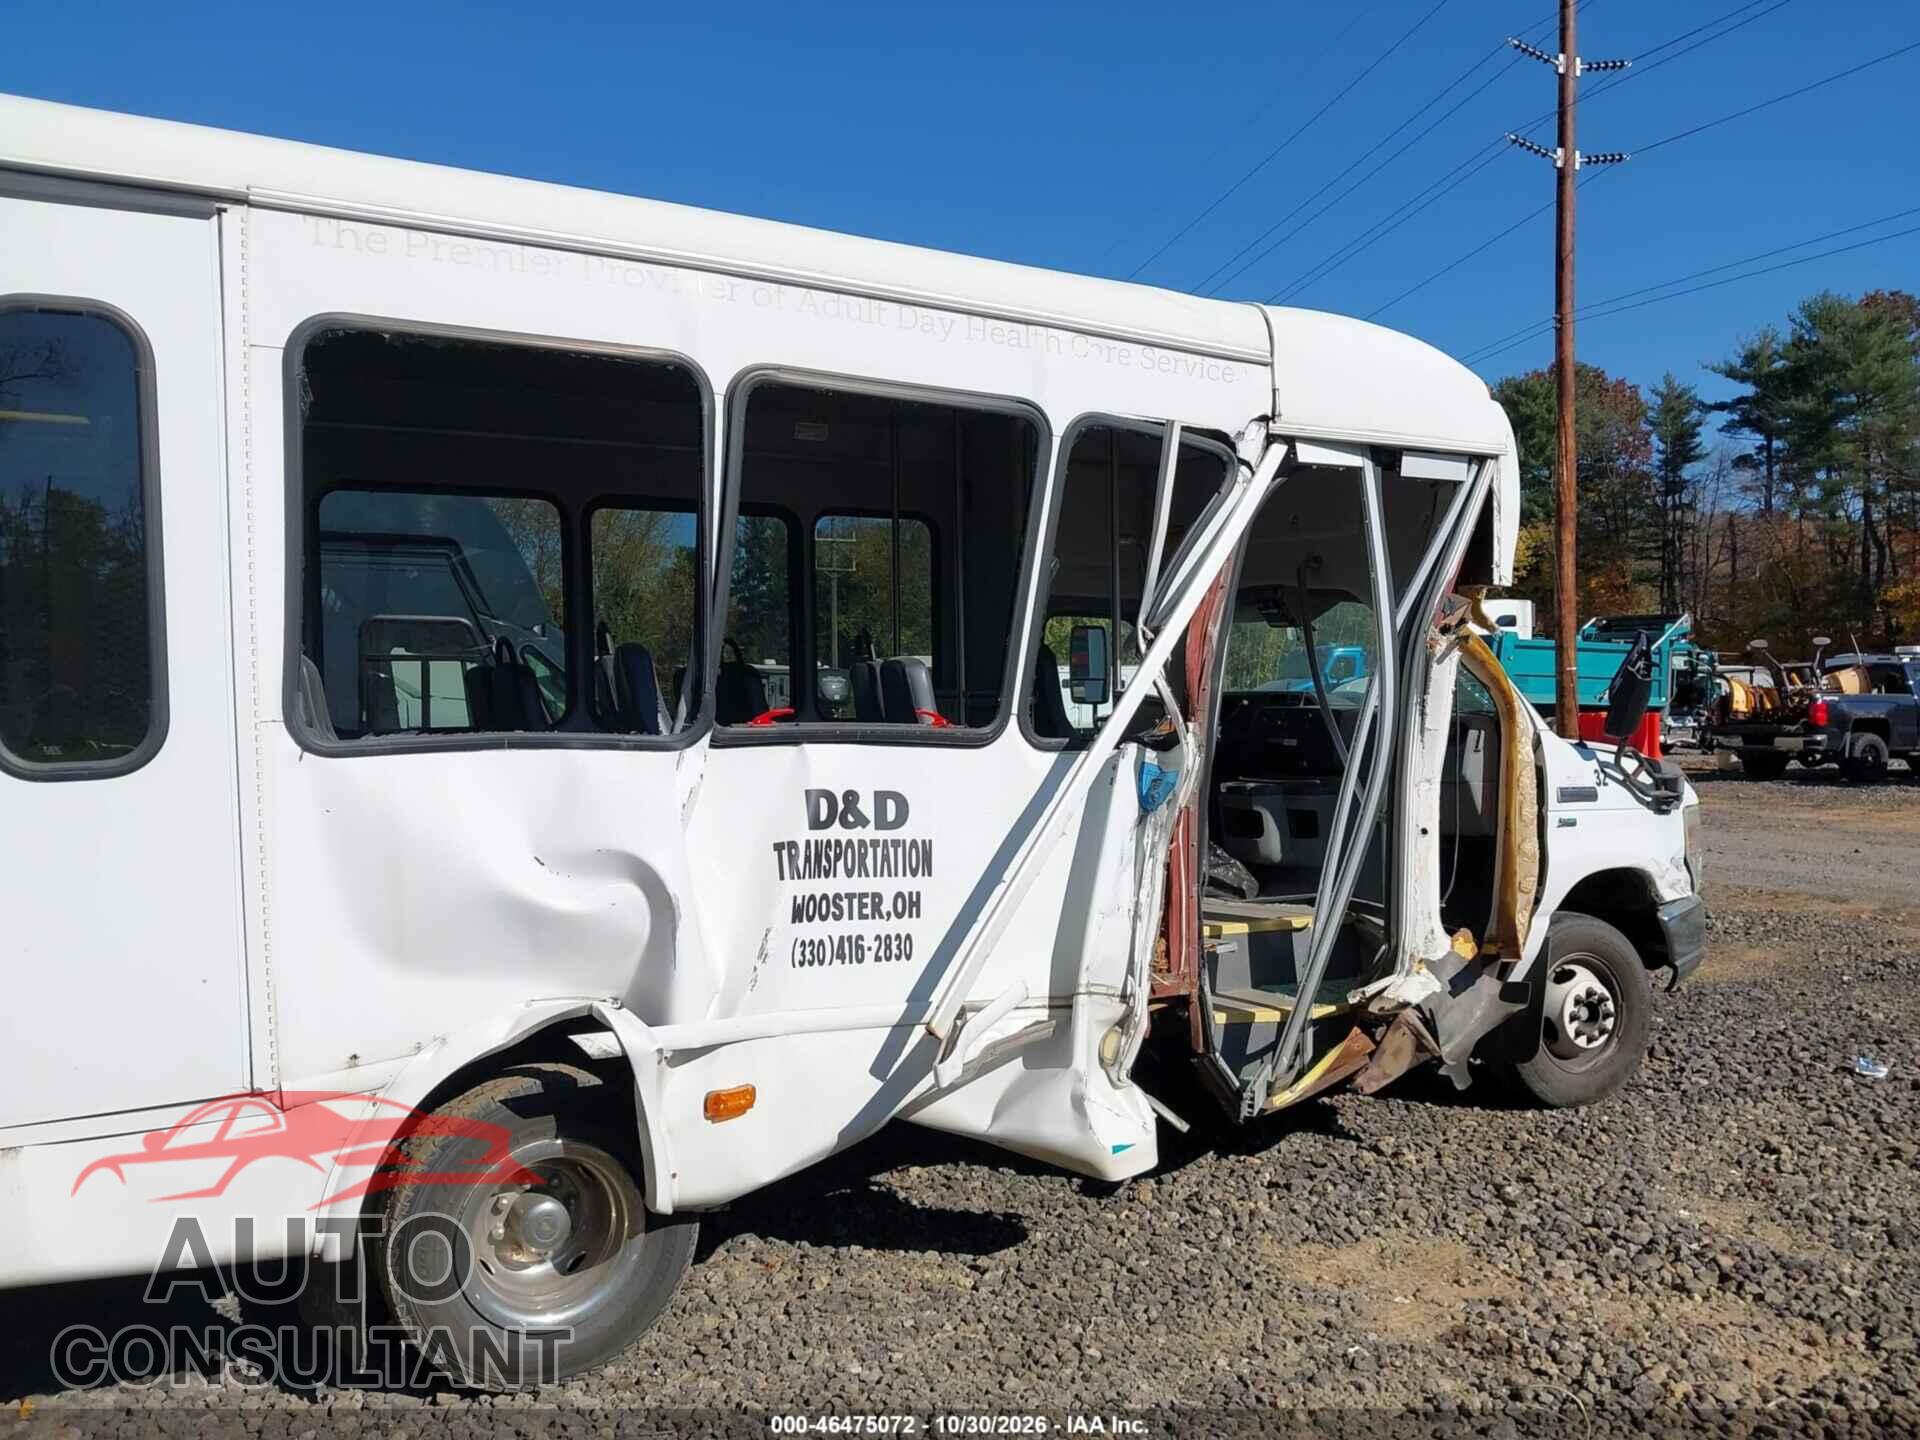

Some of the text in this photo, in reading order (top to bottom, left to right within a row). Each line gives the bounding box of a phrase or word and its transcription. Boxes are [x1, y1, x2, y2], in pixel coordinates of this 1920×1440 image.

[751, 285, 785, 312] of
[795, 289, 889, 328] Adult
[897, 304, 957, 343] Day
[962, 316, 1063, 355] Health
[804, 788, 910, 831] D&D
[773, 838, 933, 881] TRANSPORTATION
[791, 933, 913, 968] (330)416-2830
